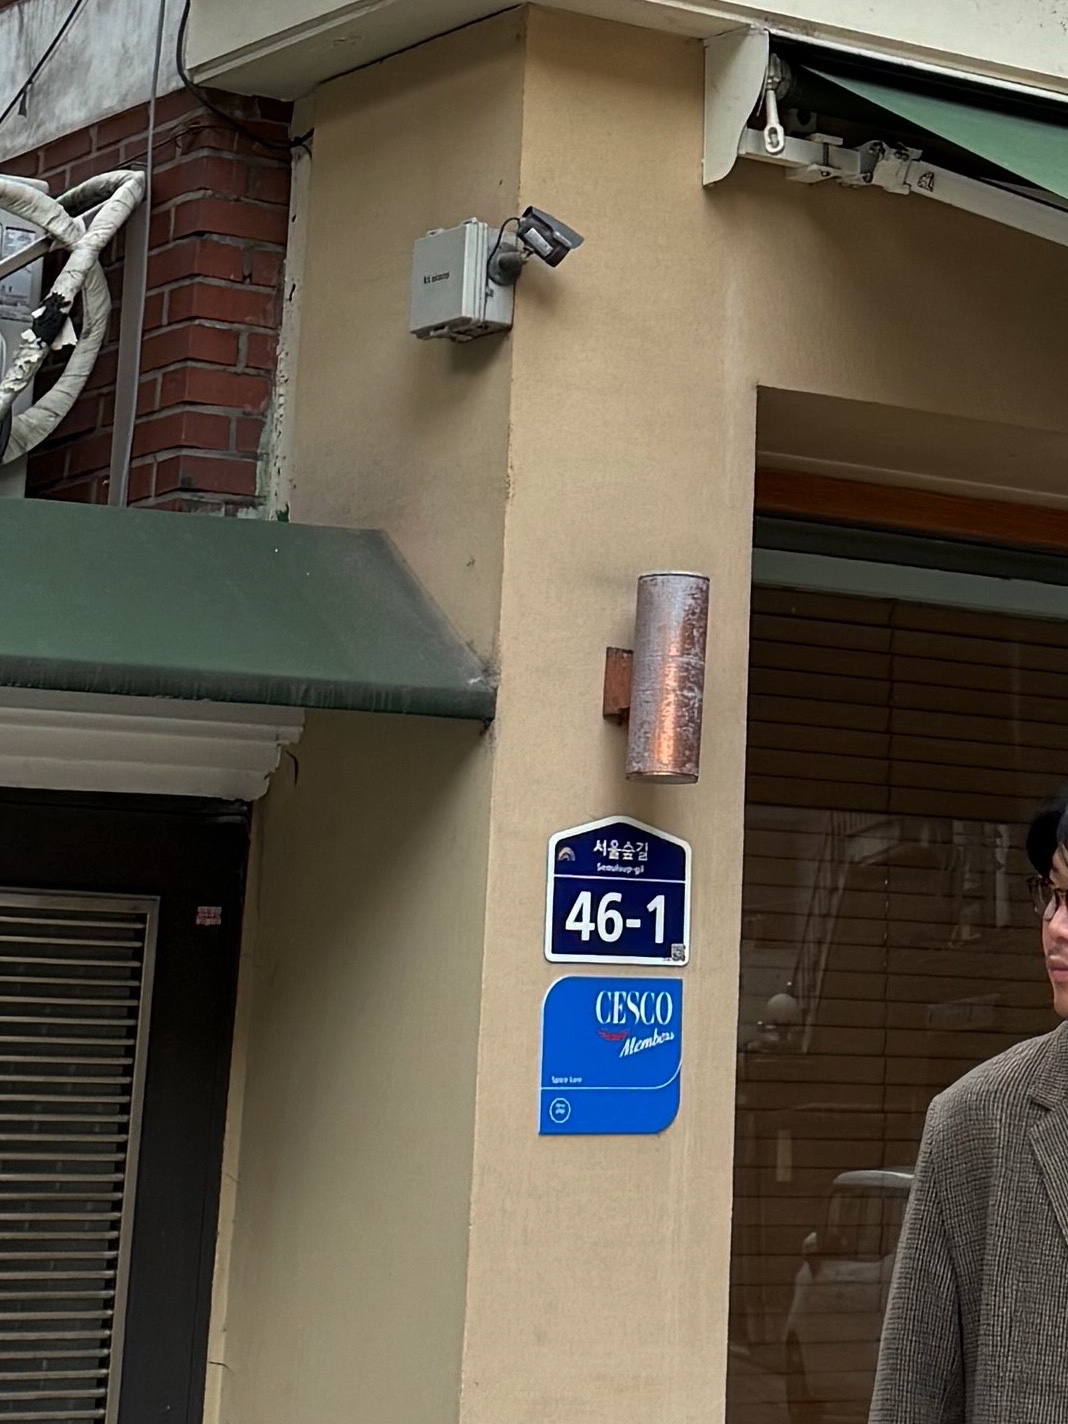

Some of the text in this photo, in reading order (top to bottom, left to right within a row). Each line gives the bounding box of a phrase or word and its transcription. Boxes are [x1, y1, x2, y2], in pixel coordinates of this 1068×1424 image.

[592, 838, 649, 862] 서울숲길
[564, 890, 666, 944] 46-1
[595, 990, 674, 1026] CESCO
[618, 1028, 675, 1059] Members
